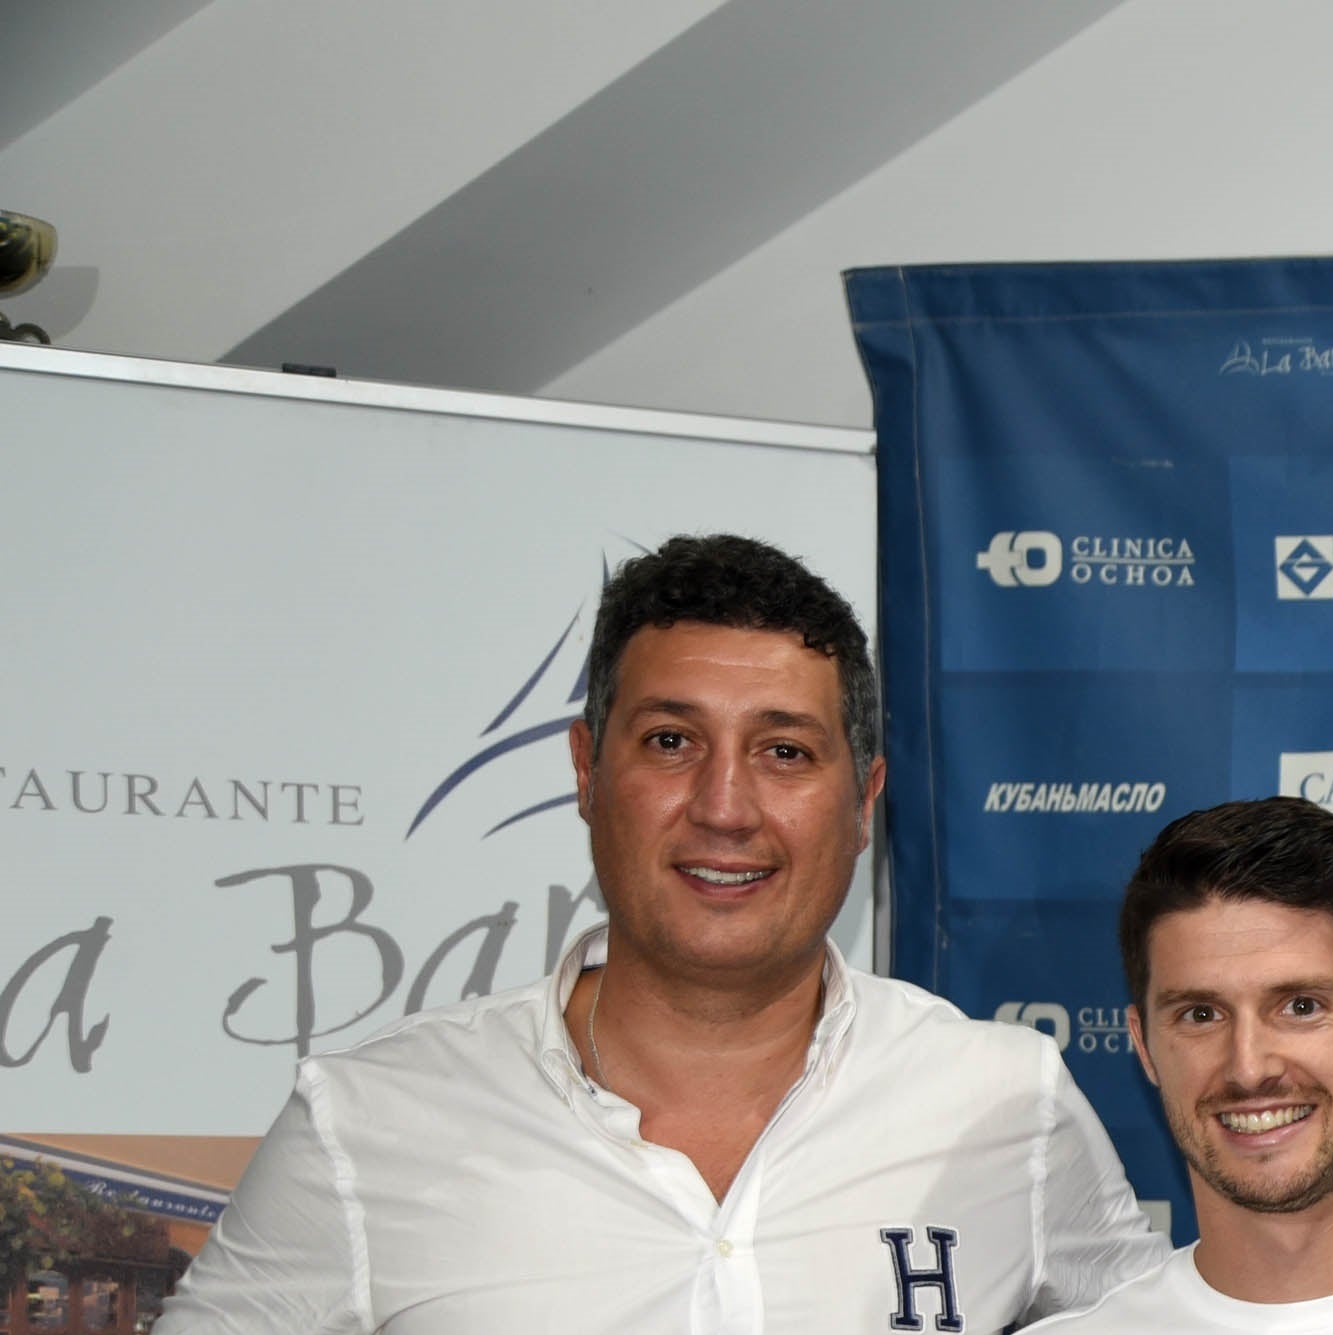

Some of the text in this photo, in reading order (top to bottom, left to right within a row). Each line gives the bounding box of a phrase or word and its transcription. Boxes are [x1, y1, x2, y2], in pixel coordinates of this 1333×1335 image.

[1261, 349, 1292, 376] La
[1071, 536, 1194, 558] CLINICA
[1071, 563, 1195, 586] OCHOA
[1078, 1007, 1130, 1027] CLI
[880, 1227, 964, 1334] H
